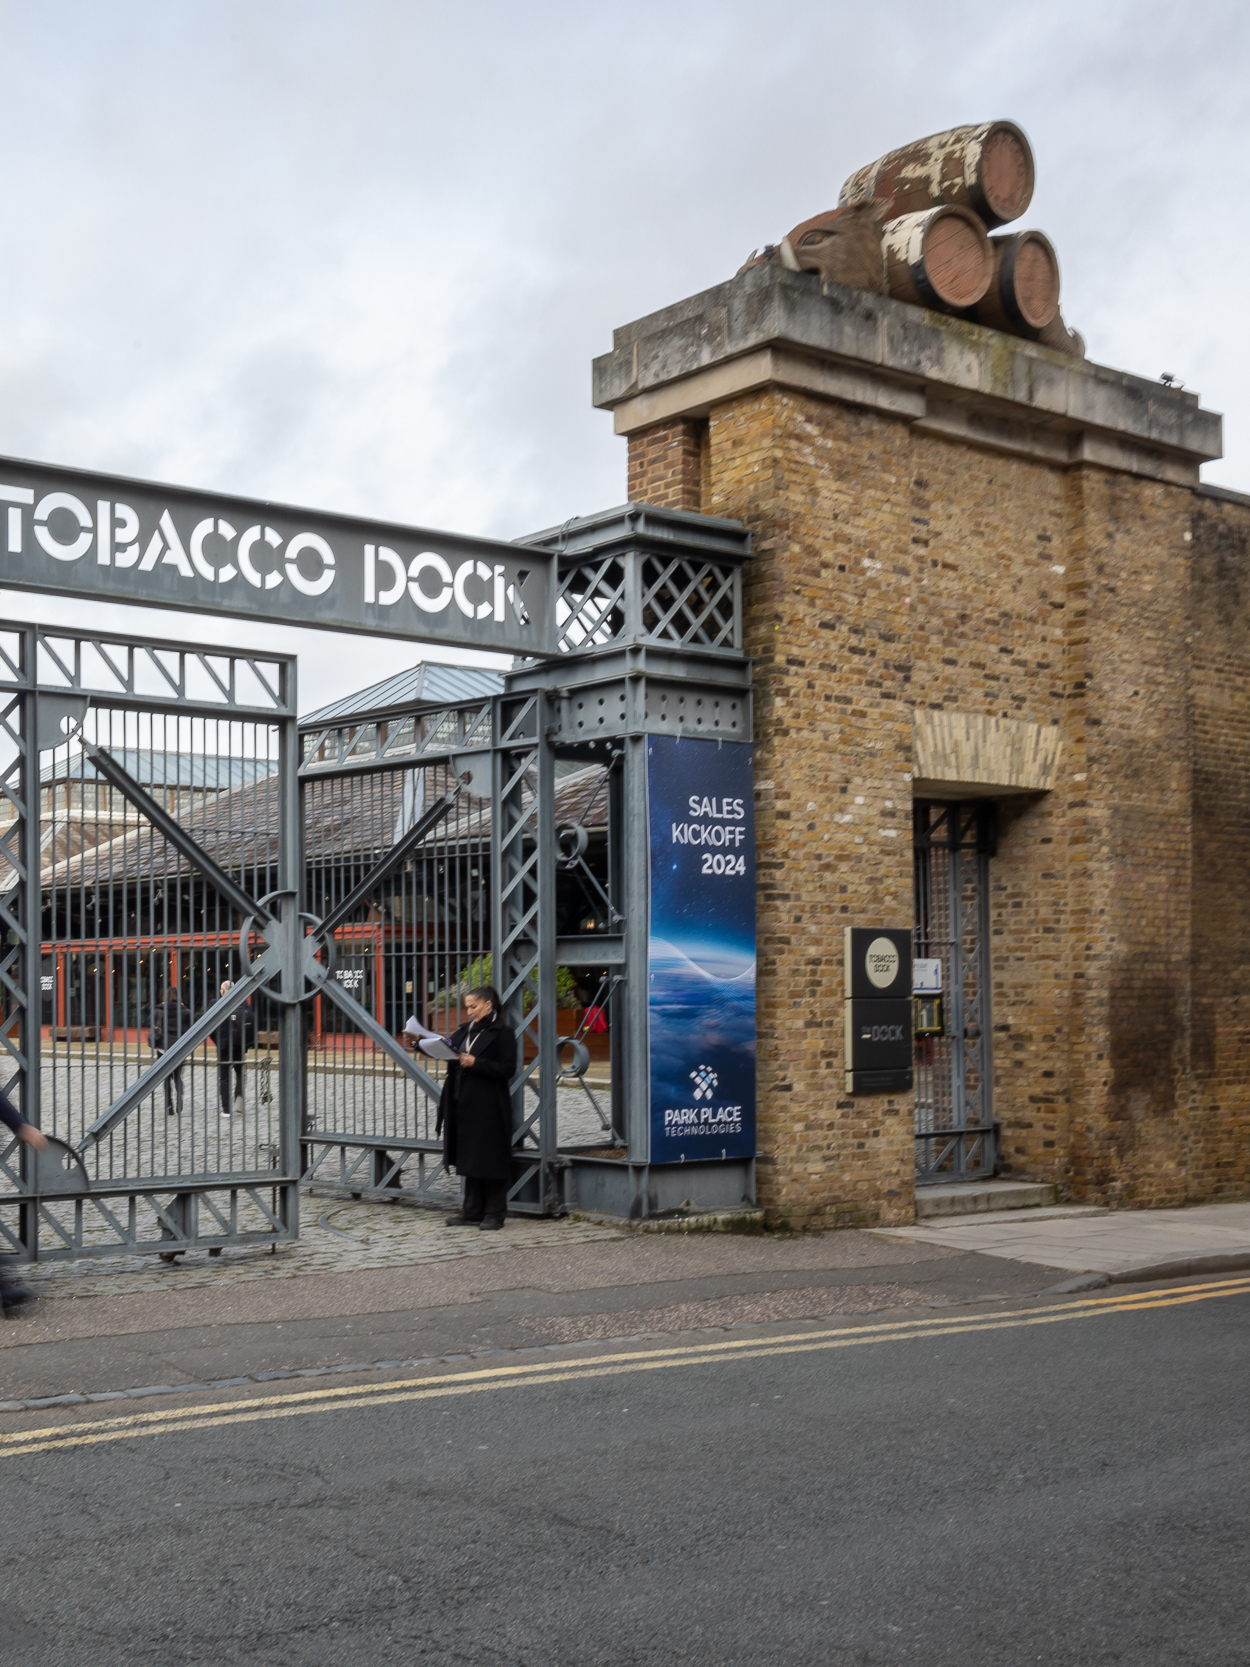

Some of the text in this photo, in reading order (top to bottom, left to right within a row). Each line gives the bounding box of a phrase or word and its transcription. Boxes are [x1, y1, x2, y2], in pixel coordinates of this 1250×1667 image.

[363, 543, 532, 626] DOCK
[688, 795, 745, 820] SALES
[671, 822, 746, 848] KICKOFF
[701, 852, 747, 876] 2024
[871, 1024, 904, 1041] DOCK
[664, 1105, 743, 1126] PARK PLACE
[664, 1122, 743, 1138] TECHNOLOGIES
